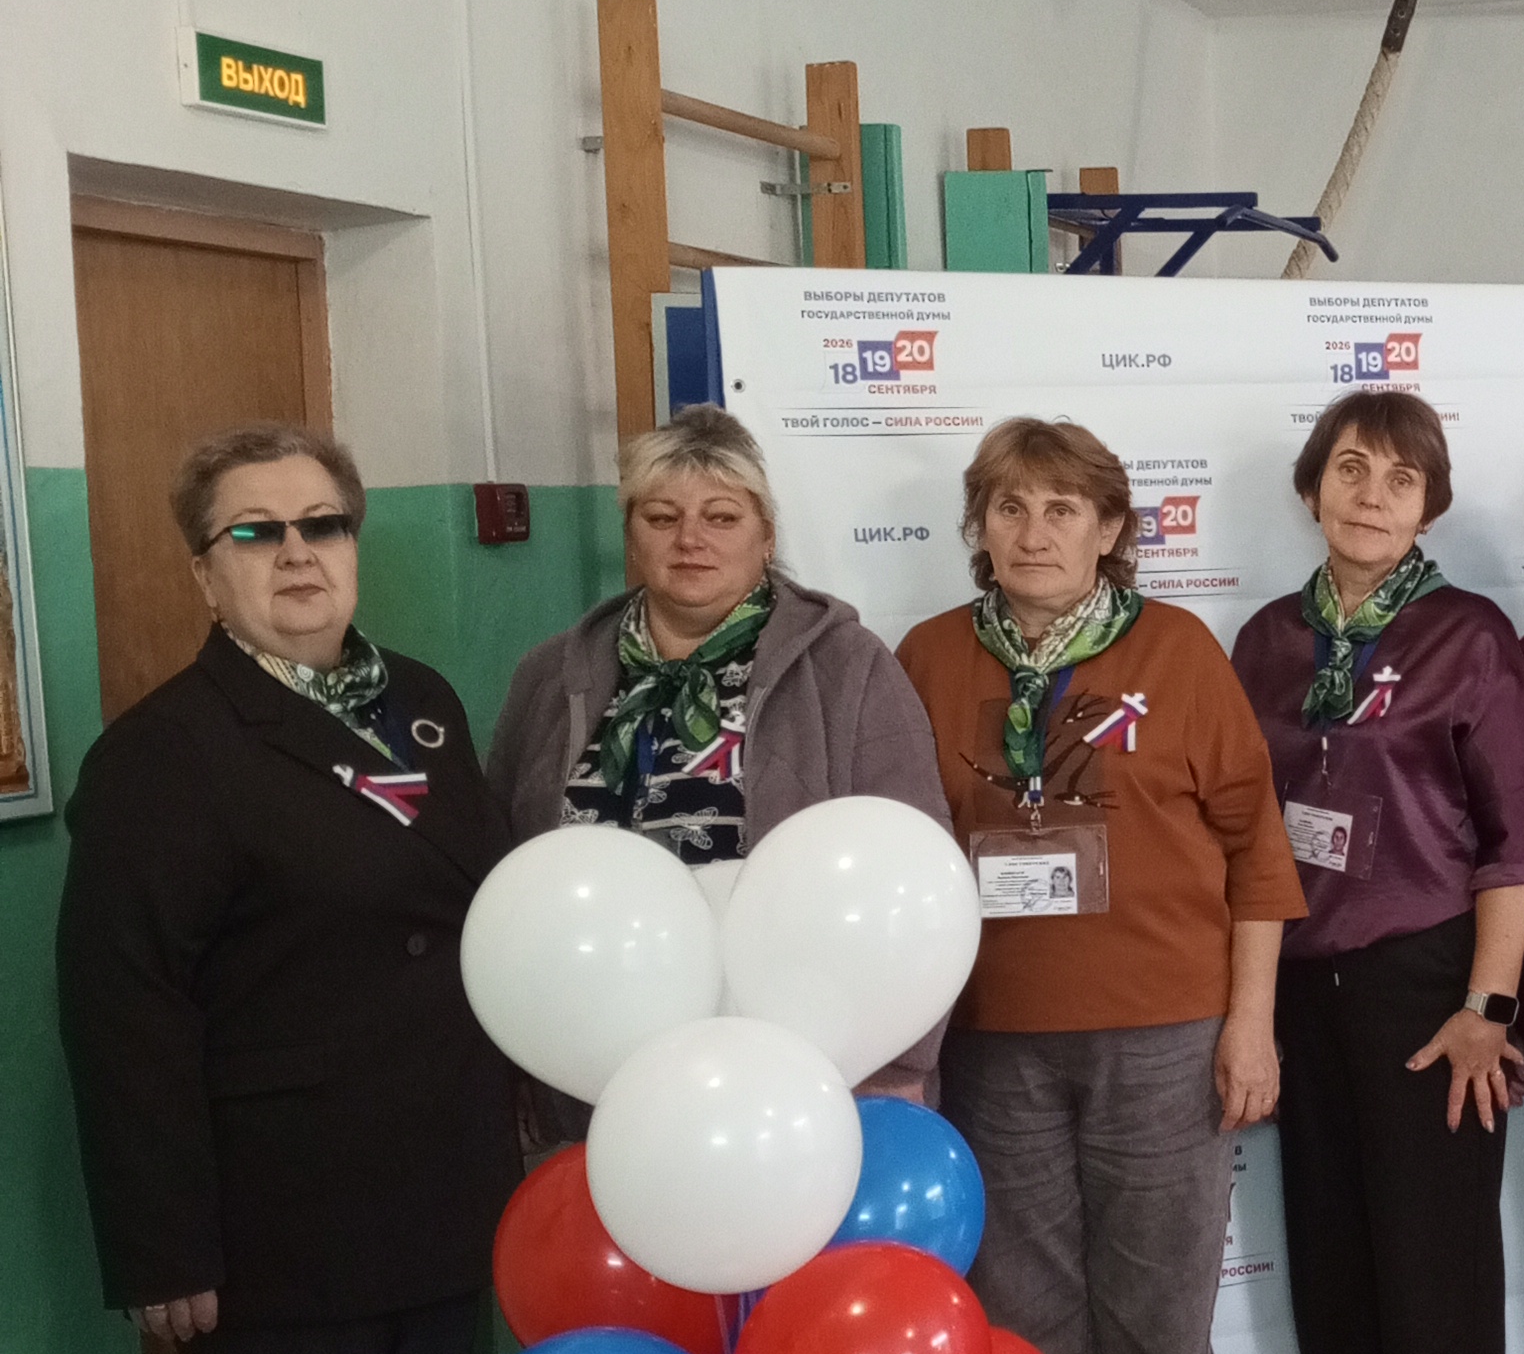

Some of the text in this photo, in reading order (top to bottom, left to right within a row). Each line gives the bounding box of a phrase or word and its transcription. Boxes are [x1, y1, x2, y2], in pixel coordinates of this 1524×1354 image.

[220, 56, 306, 108] ВЫХОД
[803, 290, 946, 303] ВЫБОРЫ ДЕПУТАТОВ
[1309, 297, 1429, 308] ВЫБОРЫ ДЕПУТАТОВ
[801, 309, 951, 321] ГОСУДАРСТВЕННОЙ ДУМЫ
[1307, 313, 1433, 324] ГОСУДАРСТВЕННОЙ ДУМЫ
[823, 338, 853, 348] 2026
[1325, 341, 1351, 350] 2026
[829, 339, 931, 384] 18 19 20
[1101, 353, 1172, 370] ЦИК.РФ
[1330, 341, 1416, 383] 18 19 20
[868, 384, 937, 394] СЕНТЯБРЯ
[782, 415, 820, 428] ТВОЙ
[823, 416, 869, 428] ГОЛОС
[885, 416, 922, 427] СИЛА
[925, 416, 984, 427] РОССИИ!
[1136, 459, 1208, 471] ДЕПУТАТОВ
[1181, 476, 1213, 487] ДУМЫ
[1137, 505, 1194, 538] 9 20
[853, 526, 930, 545] ЦИК.РФ
[1136, 547, 1199, 558] СЕНТЯБРЯ
[1150, 579, 1184, 590] СИЛА
[1186, 577, 1240, 588] РОССИИ!
[1221, 1261, 1275, 1278] РОССИИ!
